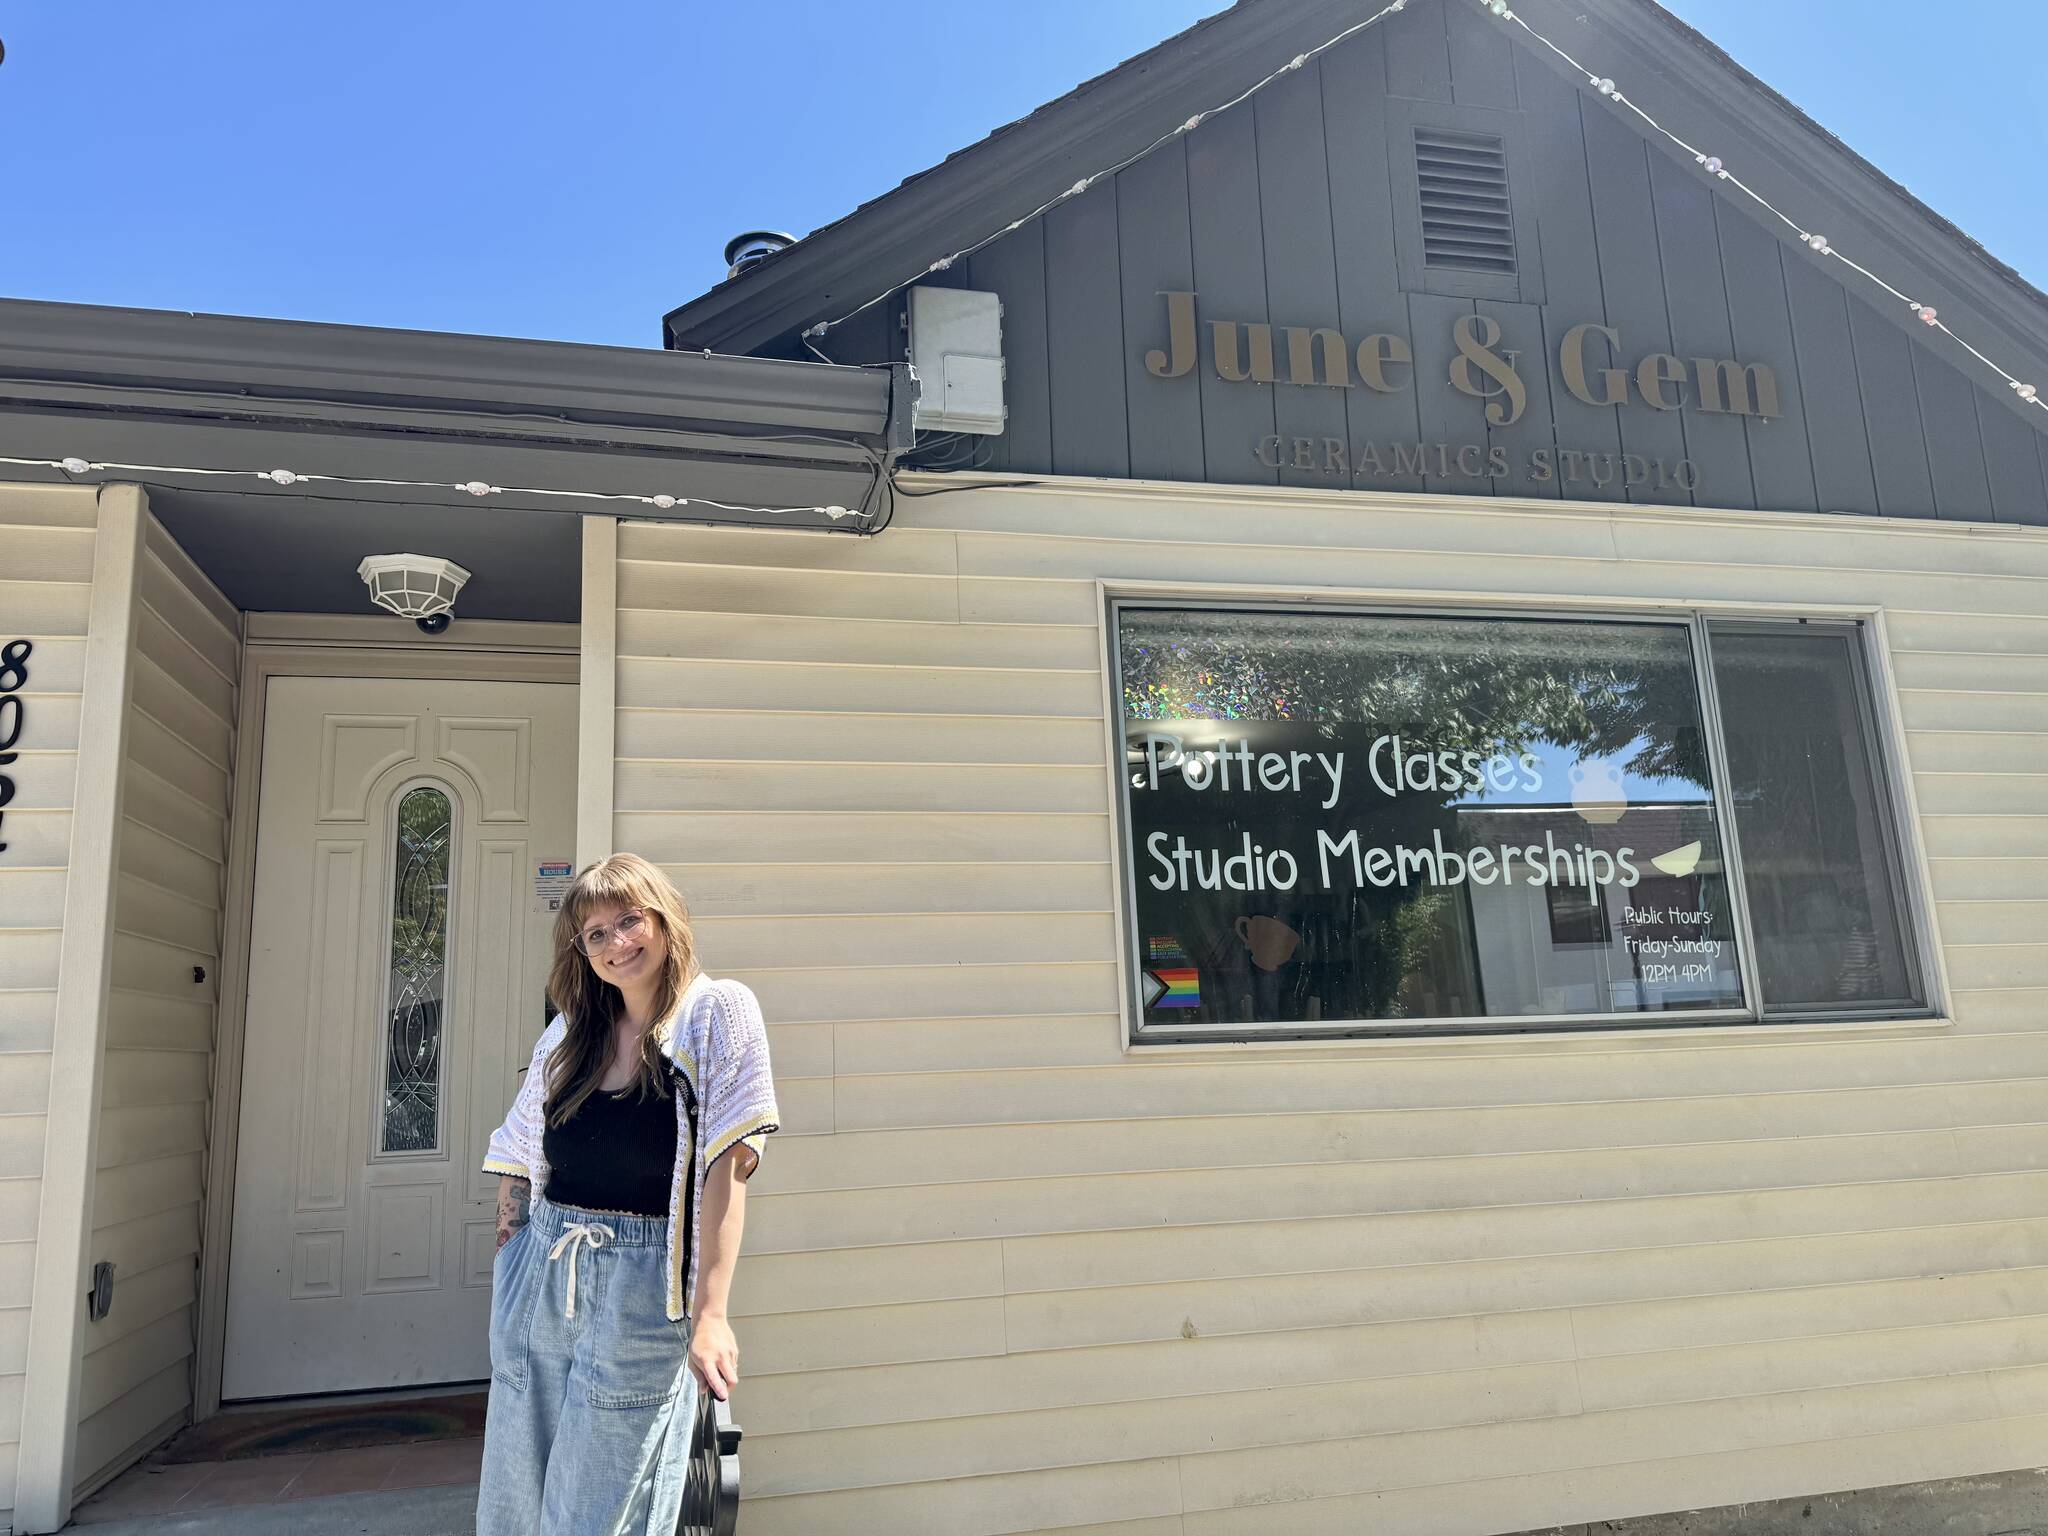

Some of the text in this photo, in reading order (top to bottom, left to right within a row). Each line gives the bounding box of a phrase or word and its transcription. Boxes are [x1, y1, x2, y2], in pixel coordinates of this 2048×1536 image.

[1144, 291, 1784, 426] June & Gem
[1257, 434, 1699, 490] CERAMICS STUDIO
[1147, 733, 1543, 809] Pottery Classes
[1147, 829, 1640, 906] Studio Memberships
[1624, 906, 1713, 924] Public Hours:
[1623, 936, 1721, 958] Friday-Sunday
[1642, 964, 1713, 983] 12PM 4PM
